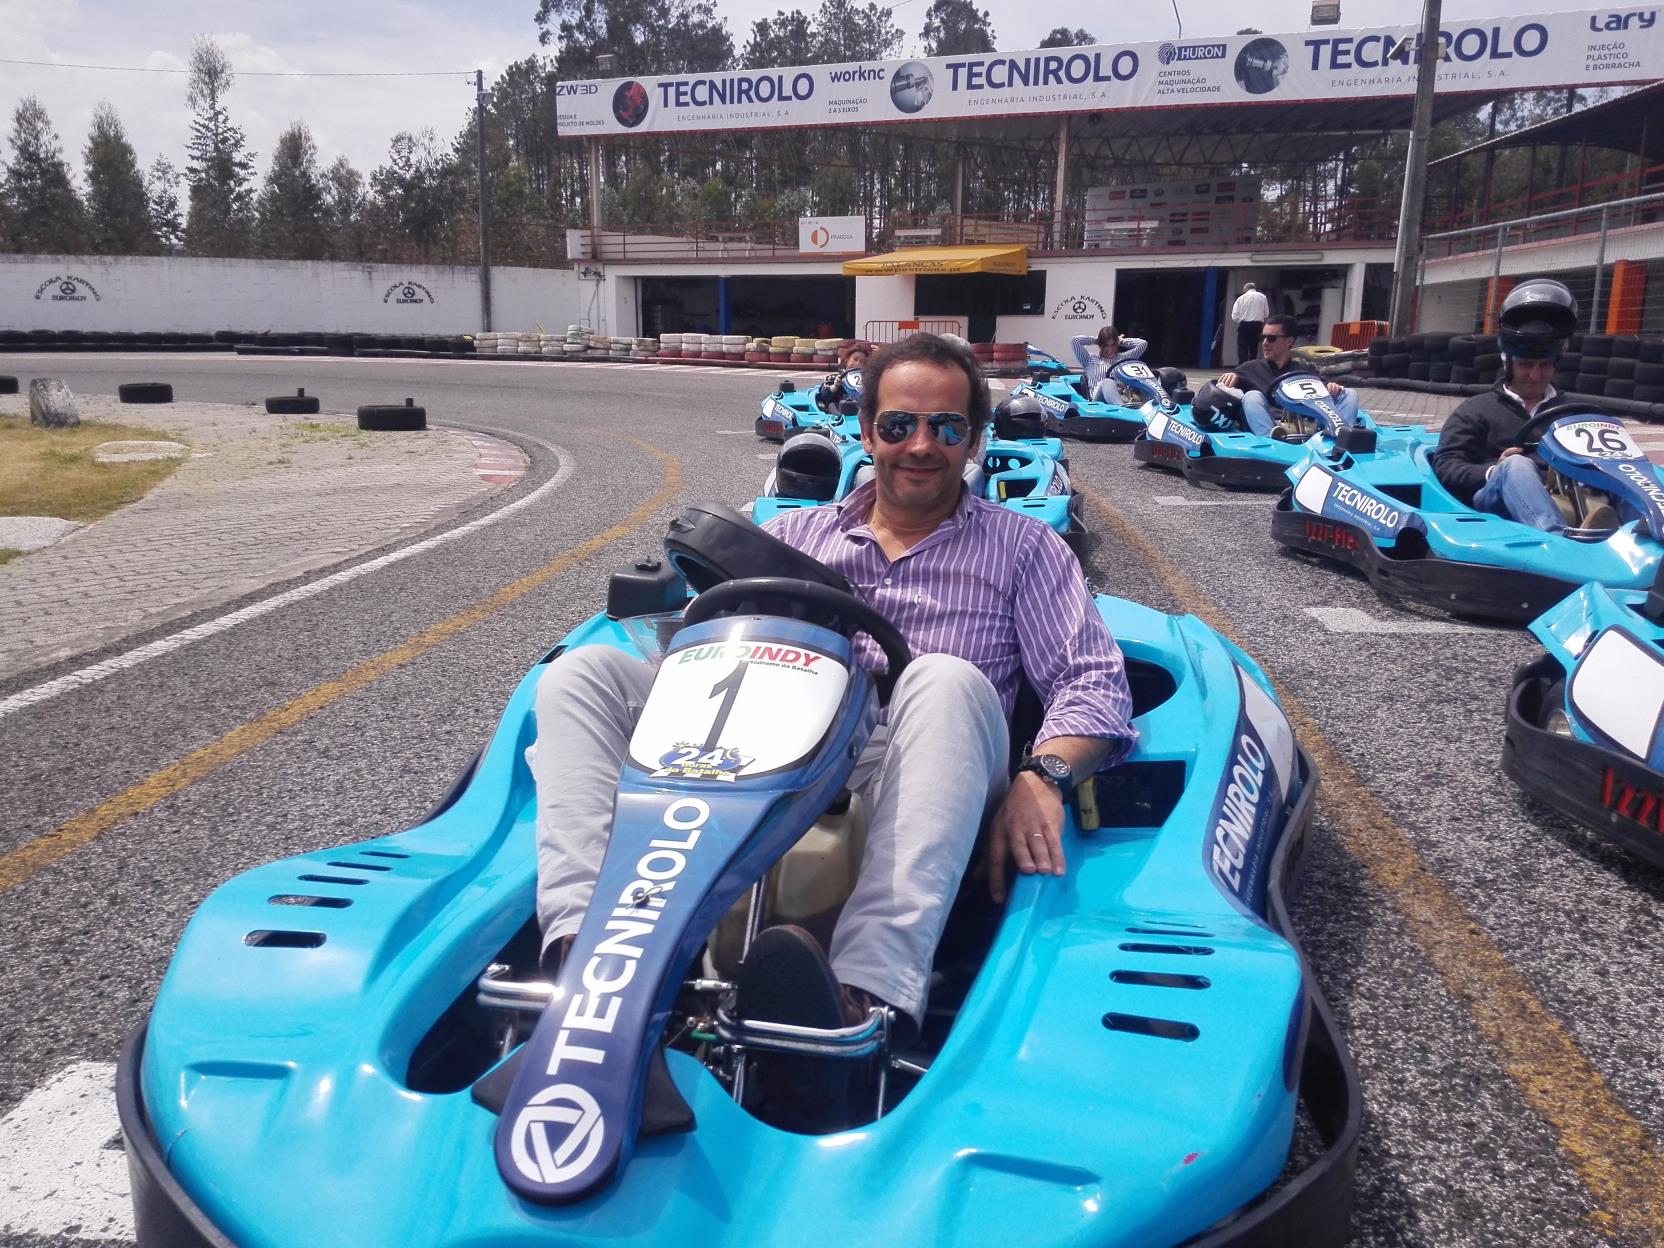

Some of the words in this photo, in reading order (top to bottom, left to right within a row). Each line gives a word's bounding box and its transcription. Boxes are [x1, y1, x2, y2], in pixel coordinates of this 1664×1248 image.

[1181, 46, 1223, 59] HURON
[1587, 41, 1625, 52] INJEÇÃO
[1585, 52, 1629, 62] PLÁSTICO
[829, 65, 885, 83] worknc
[945, 49, 1140, 92] TECNIROLO
[1158, 69, 1191, 77] CENTROS
[1592, 61, 1641, 71] BORRACHA
[1157, 77, 1207, 86] MAQUINAÇÃO
[1331, 76, 1402, 87] ENGENHARIA
[1407, 73, 1480, 83] INSTRIAL,
[657, 72, 815, 109] TECNIROLO
[1176, 85, 1221, 94] VELOCIDADE
[968, 96, 1025, 106] ENGENHARIA
[677, 113, 724, 121] ENGENHARIA
[34, 276, 62, 300] ESCOLA
[1051, 295, 1076, 320] ESCOLA
[1298, 382, 1317, 397] 5
[1167, 420, 1203, 445] TECNIROLO
[1574, 428, 1628, 453] 26
[1332, 481, 1399, 528] TECNIROLO
[791, 665, 819, 676] Batalha
[708, 660, 750, 752] 1
[671, 747, 724, 767] 24
[1212, 734, 1266, 893] TECNIROLO
[546, 797, 710, 1076] TECNIROLO
